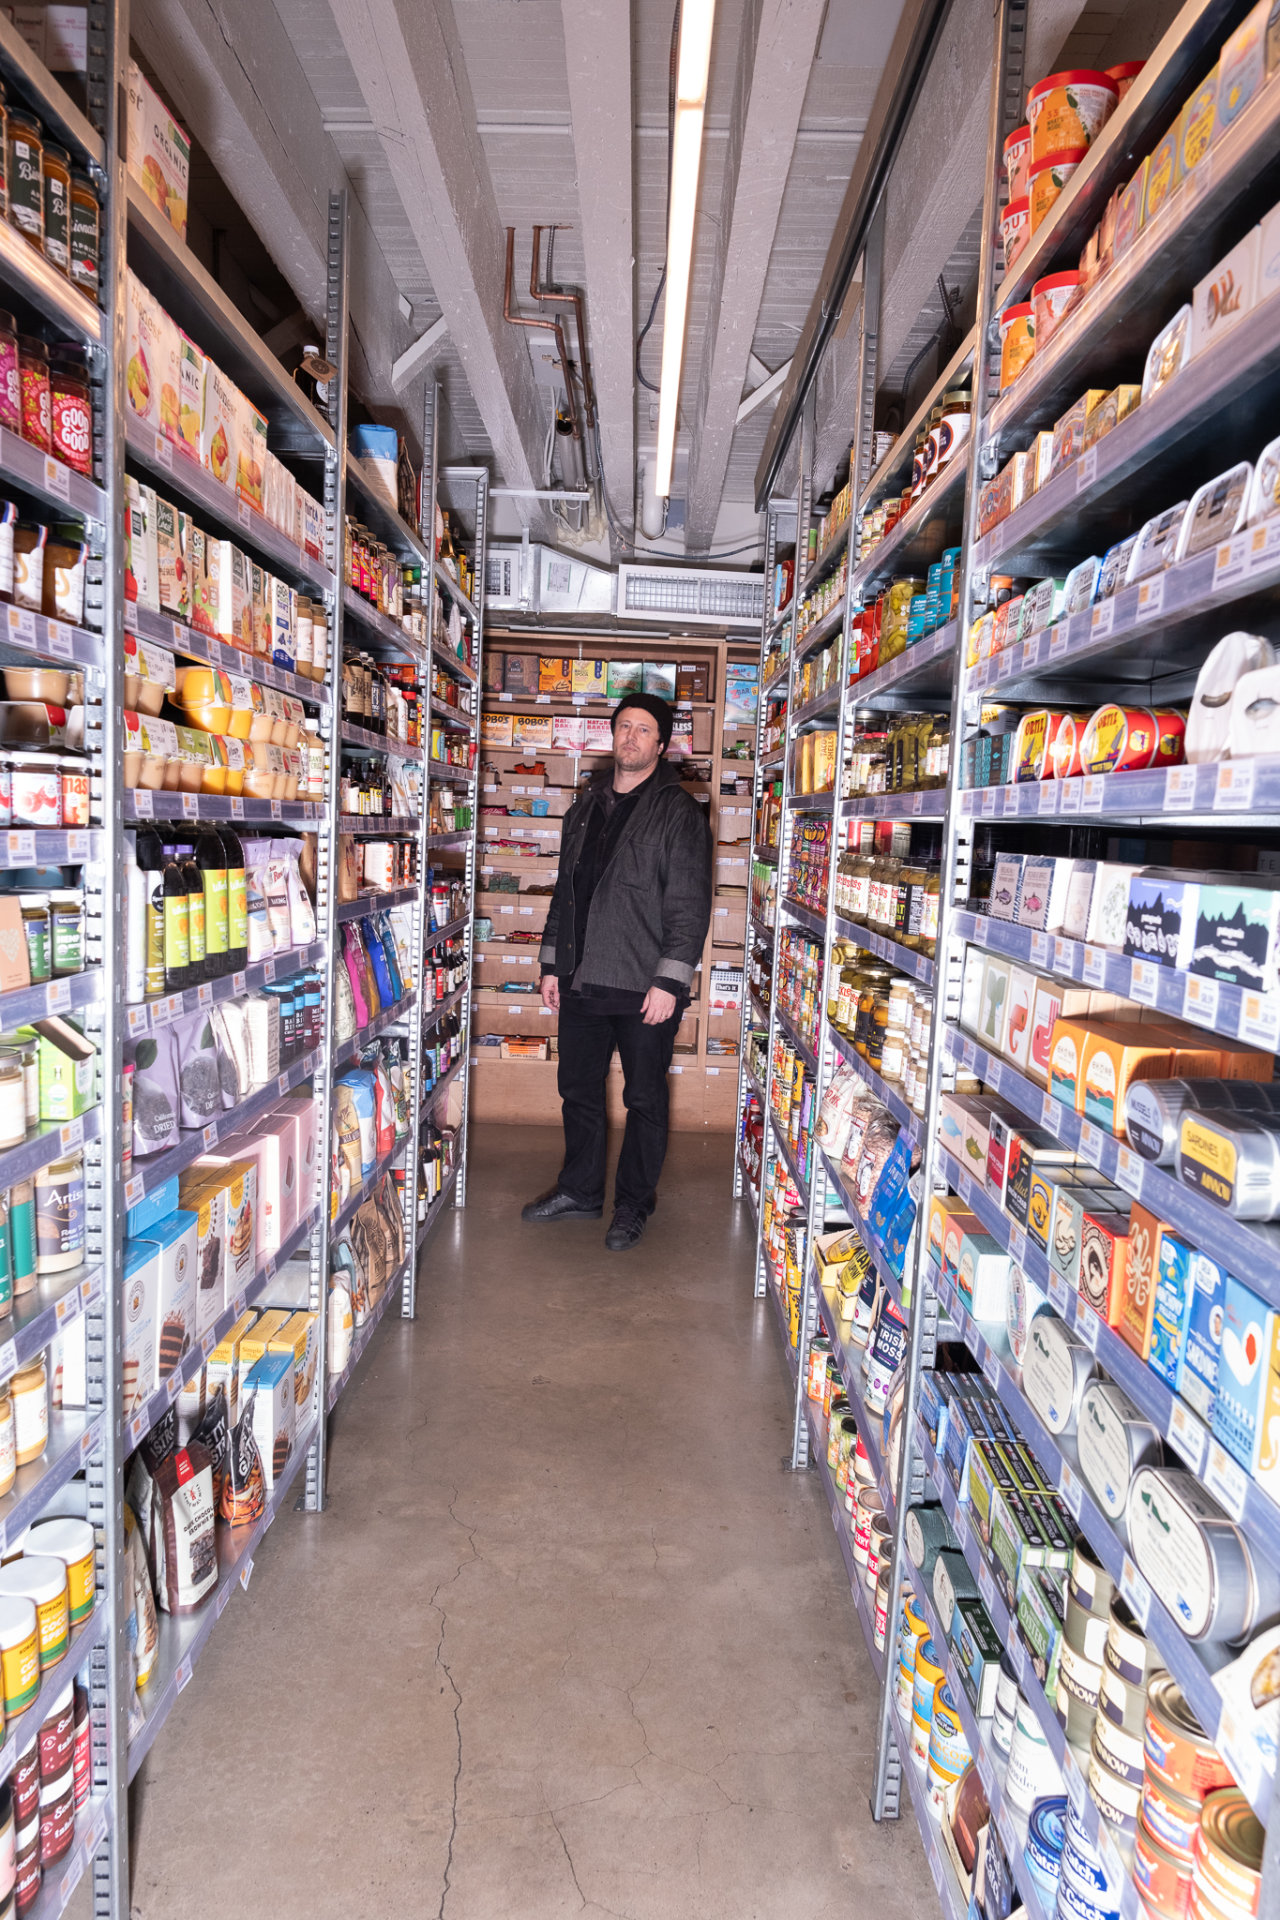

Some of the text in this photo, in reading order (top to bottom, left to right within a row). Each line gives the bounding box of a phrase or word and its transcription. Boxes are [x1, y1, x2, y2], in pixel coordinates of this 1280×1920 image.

[153, 124, 187, 179] ORGANIC
[61, 408, 89, 431] GOOD
[61, 427, 89, 452] GOOD
[518, 717, 549, 726] BOBO'S
[153, 1119, 175, 1134] DRIED
[1187, 1130, 1219, 1158] SARDINES
[880, 1328, 907, 1351] IRISH
[876, 1340, 903, 1364] MOSS
[189, 1517, 210, 1536] BROWNIE
[195, 1506, 214, 1524] CHOCOL
[855, 1533, 868, 1548] ERRY
[1020, 1601, 1048, 1653] OYSTERS
[943, 1757, 966, 1770] TUNA
[1031, 1844, 1061, 1879] Catch
[1065, 1842, 1095, 1884] Catch
